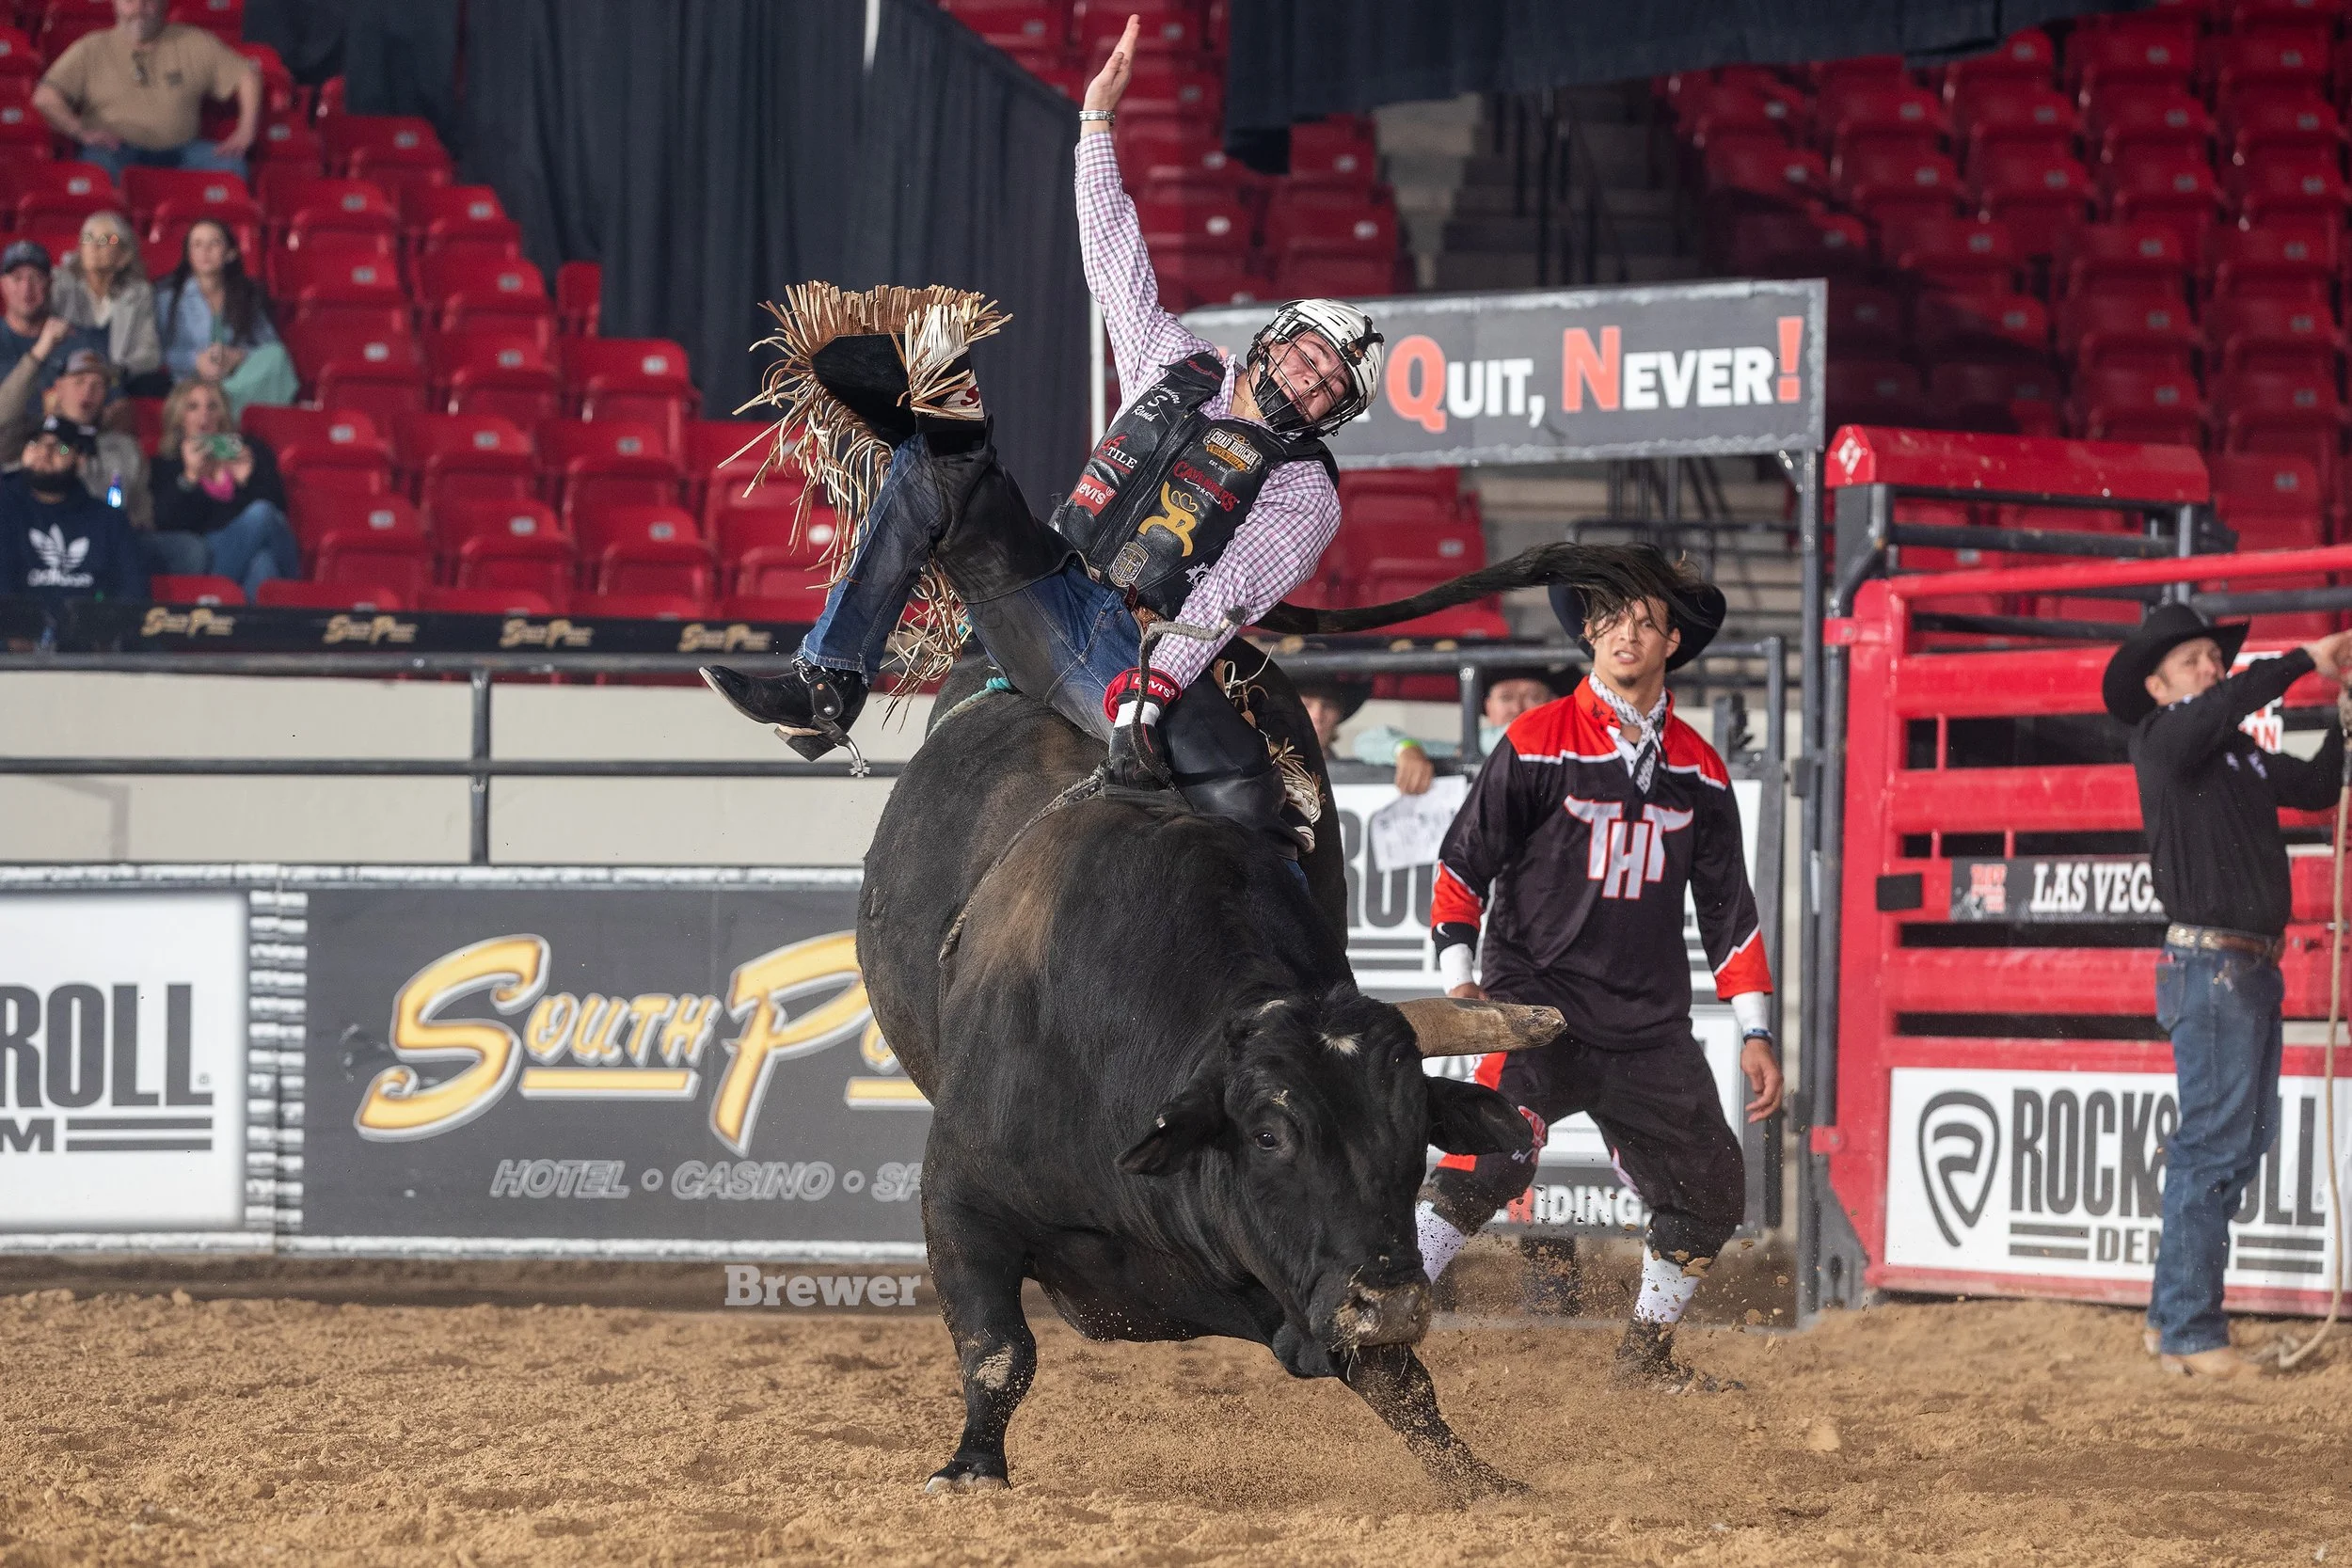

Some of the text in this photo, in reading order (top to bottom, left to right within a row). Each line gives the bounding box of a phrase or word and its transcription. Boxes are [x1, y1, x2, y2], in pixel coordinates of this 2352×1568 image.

[1386, 315, 1804, 434] QUIT, NEVER!
[1131, 404, 1159, 422] Ranch
[1107, 446, 1138, 469] TILE
[1210, 431, 1232, 450] CHAD
[1228, 441, 1259, 467] BERGER
[1564, 793, 1694, 901] THT
[2029, 862, 2090, 913] LAS
[354, 933, 723, 1142] SOUTH
[489, 1158, 631, 1199] HOTEL
[670, 1160, 835, 1201] CASINO
